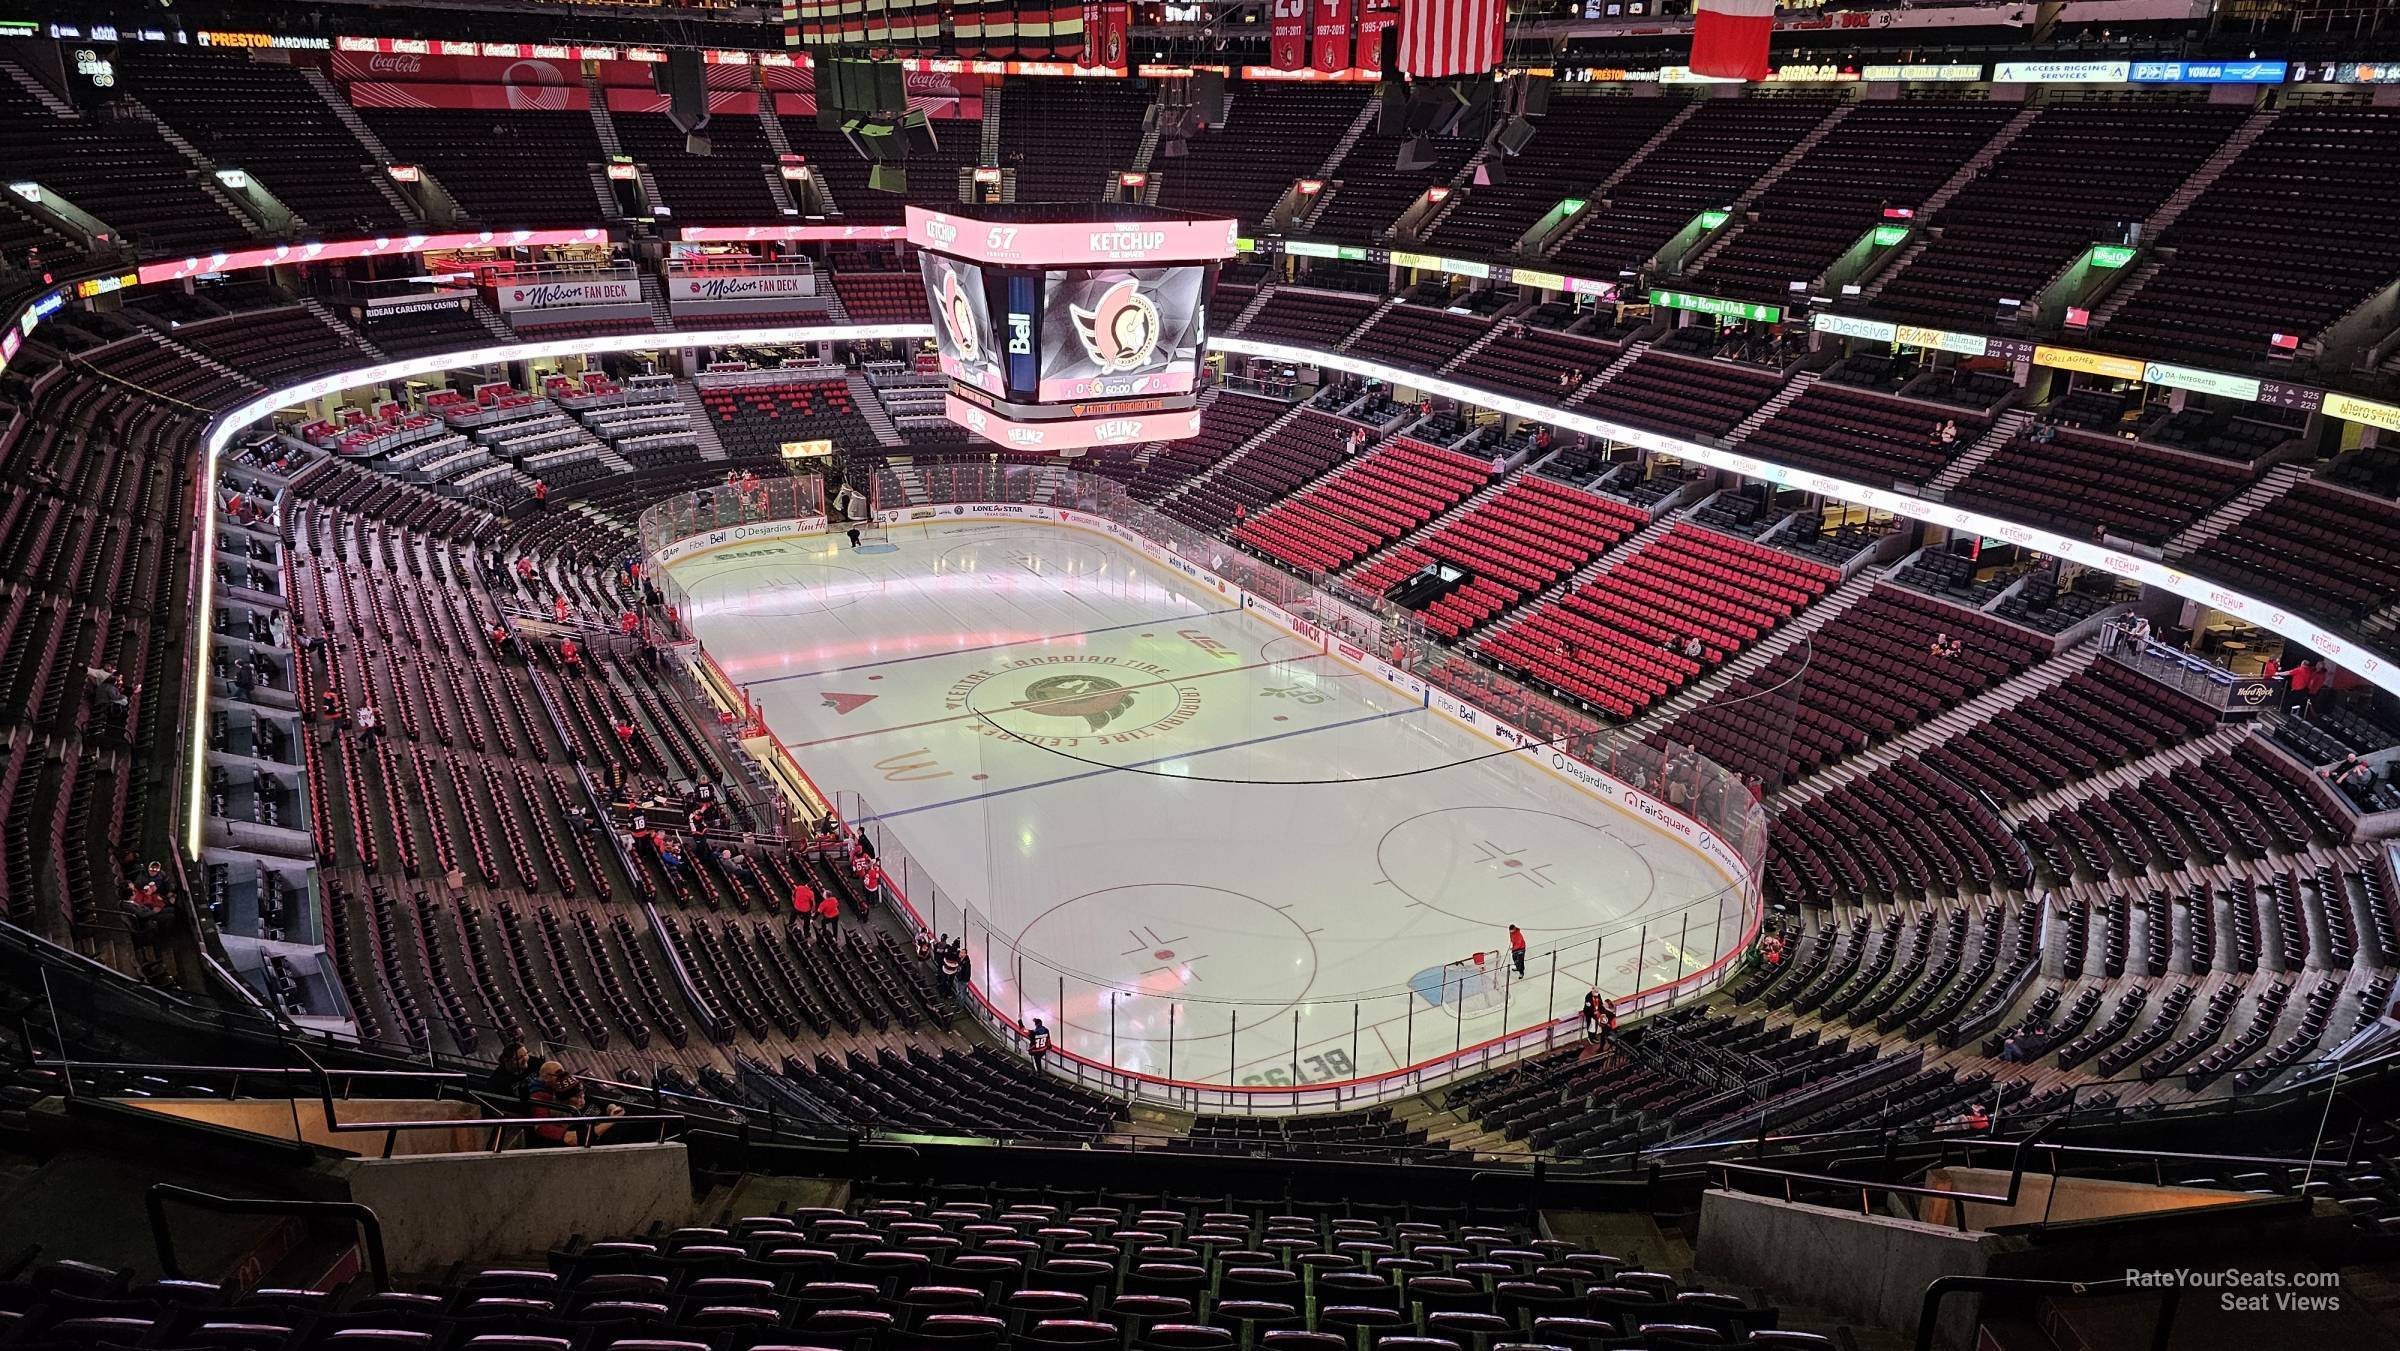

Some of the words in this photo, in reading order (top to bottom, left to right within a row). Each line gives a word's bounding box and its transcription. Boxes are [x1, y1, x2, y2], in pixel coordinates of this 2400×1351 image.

[1842, 13, 1872, 28] BOX
[1276, 25, 1302, 36] 2001-2017
[210, 32, 272, 48] PRESTON
[272, 36, 331, 49] HARDWARE
[75, 50, 97, 62] GO
[369, 53, 422, 73] Coca-Cola
[78, 61, 114, 74] SENS
[1779, 65, 1838, 81] SIGNS.CA
[2064, 64, 2108, 72] RIGGING
[2188, 67, 2222, 78] YOW.CA
[93, 74, 114, 87] GO
[908, 71, 951, 88] Coca-Cola
[1592, 69, 1626, 80] PRESTON
[1624, 71, 1659, 82] HARDWARE
[926, 220, 956, 243] KETCHUP
[987, 227, 1018, 250] 57
[1089, 232, 1165, 251] KETCHUP
[1399, 254, 1420, 266] MNP
[526, 285, 582, 305] Molson
[585, 286, 603, 299] FAN
[604, 284, 628, 298] DECK
[702, 278, 757, 298] Molson
[759, 280, 775, 292] FAN
[777, 279, 798, 292] DECK
[366, 307, 395, 318] RIDEAU
[395, 303, 433, 316] CARLETON
[433, 300, 459, 313] CASINO
[1679, 294, 1696, 310] The
[1697, 297, 1725, 316] Royal
[1725, 301, 1746, 316] Oak
[1008, 313, 1031, 355] Bell
[1833, 318, 1890, 340] Decisive
[1899, 325, 1941, 346] RE/MAX
[1942, 333, 1985, 347] Hallmark
[1989, 339, 2003, 348] 323
[2018, 344, 2032, 352] 324
[1987, 350, 2000, 358] 223
[2016, 354, 2030, 363] 224
[2045, 353, 2095, 366] GALLAGHER
[2263, 383, 2280, 394] 324
[2302, 390, 2320, 400] 325
[2261, 394, 2277, 404] 224
[2300, 401, 2317, 410] 225
[1007, 428, 1044, 442] HEINZ
[1094, 420, 1143, 440] HEINZ
[1777, 470, 1787, 479] 57
[1812, 479, 1840, 492] KETCHUP
[1863, 491, 1874, 499] 57
[1900, 501, 1931, 515] KETCHUP
[1955, 514, 1969, 523] 57
[748, 523, 792, 537] Desjardins
[796, 520, 815, 533] Tim
[710, 531, 727, 545] Bell
[2000, 527, 2033, 542] KETCHUP
[690, 539, 705, 551] Fibe
[2058, 541, 2073, 552] 57
[2104, 557, 2140, 573] KETCHUP
[2168, 574, 2182, 585] 57
[2210, 592, 2244, 610] KETCHUP
[2271, 613, 2285, 625] 57
[1292, 618, 1321, 643] BRICK
[2311, 633, 2341, 655] KETCHUP
[2364, 659, 2378, 671] 57
[946, 669, 995, 703] CENTRE
[1004, 655, 1117, 669] CANADIAN
[1126, 659, 1170, 675] TIRE
[2237, 687, 2255, 697] Hard
[2255, 687, 2274, 697] Rock
[1437, 696, 1454, 712] Fibe
[1459, 704, 1476, 725] Bell
[1566, 762, 1613, 795] Desjardins
[634, 819, 645, 830] 18
[1639, 800, 1691, 836] FairSquare
